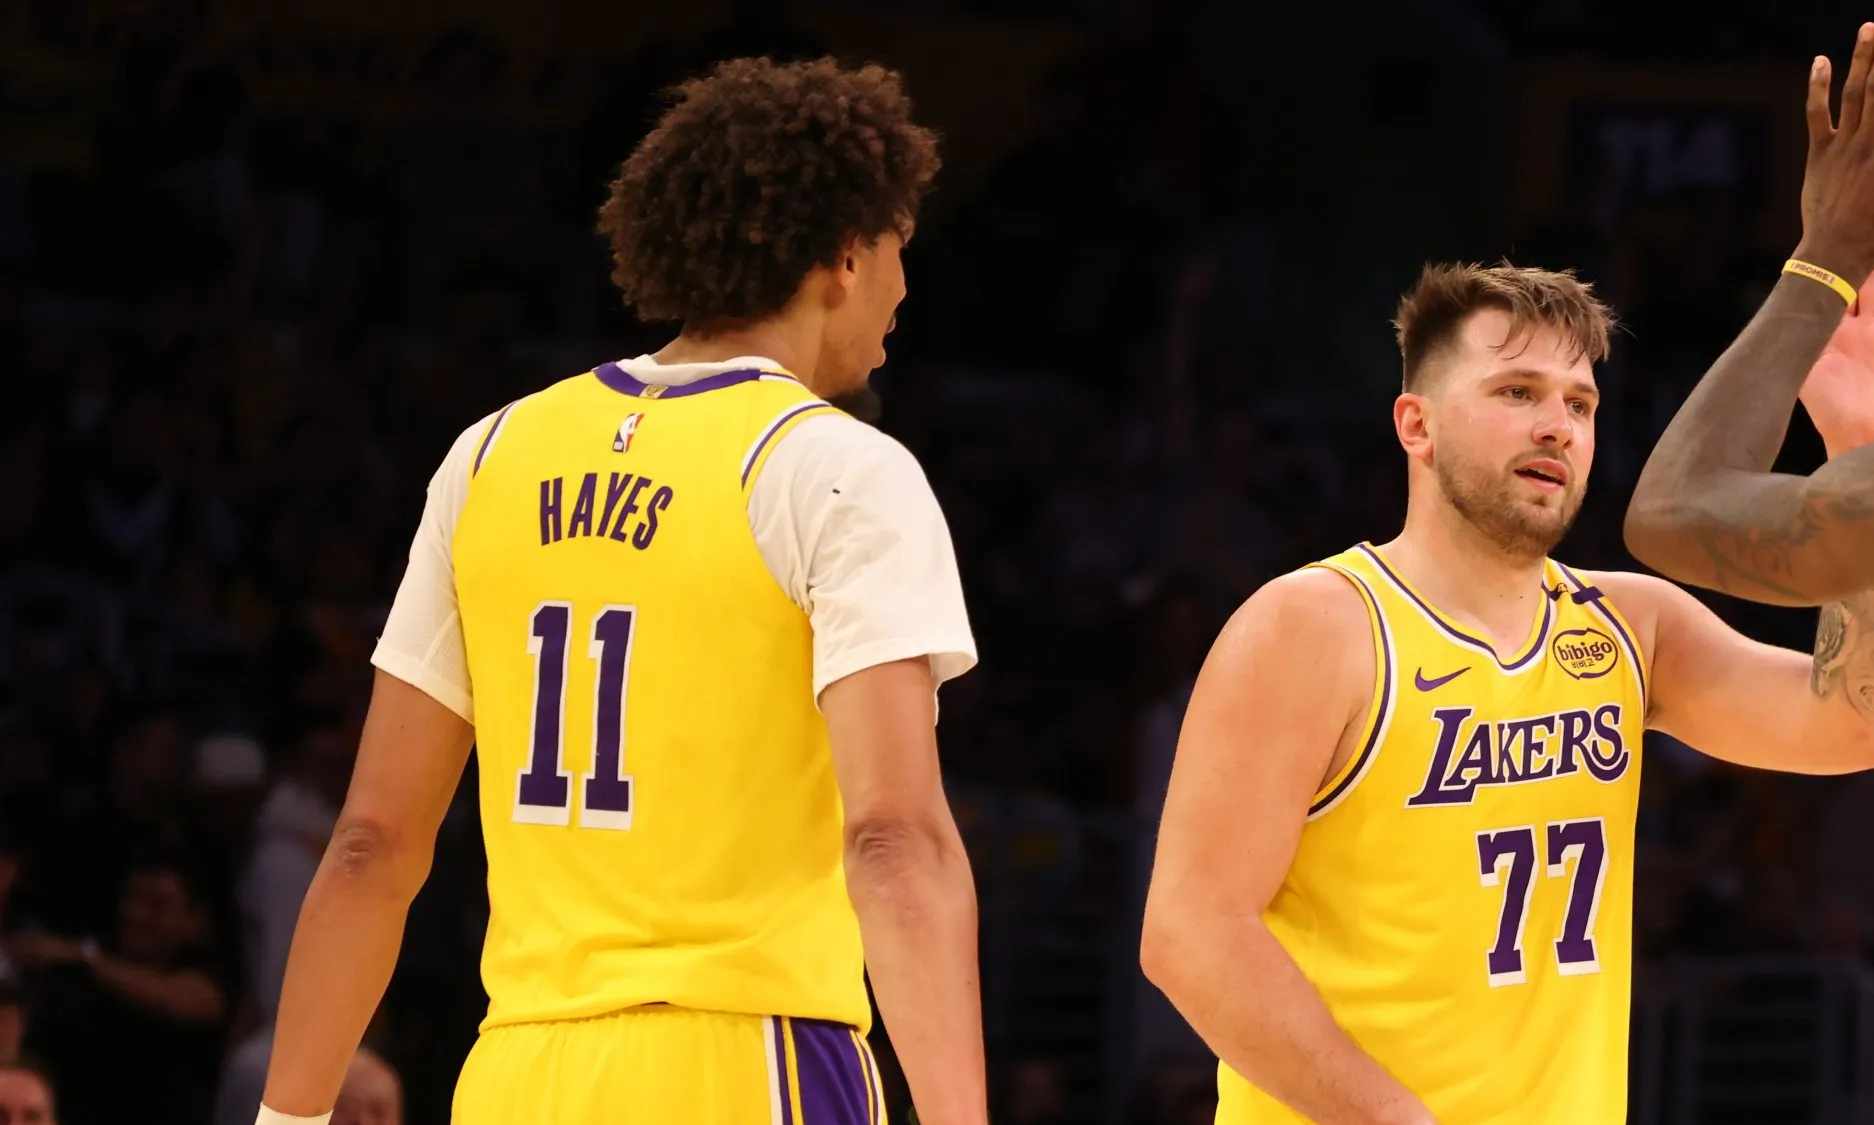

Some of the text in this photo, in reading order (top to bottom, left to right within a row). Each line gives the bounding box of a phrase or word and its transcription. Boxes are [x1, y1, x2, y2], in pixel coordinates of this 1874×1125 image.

[540, 472, 673, 550] HAYES
[1556, 641, 1613, 662] bibigo
[511, 600, 638, 831] 11
[1404, 702, 1630, 809] LAKERS
[1475, 816, 1610, 988] 77
